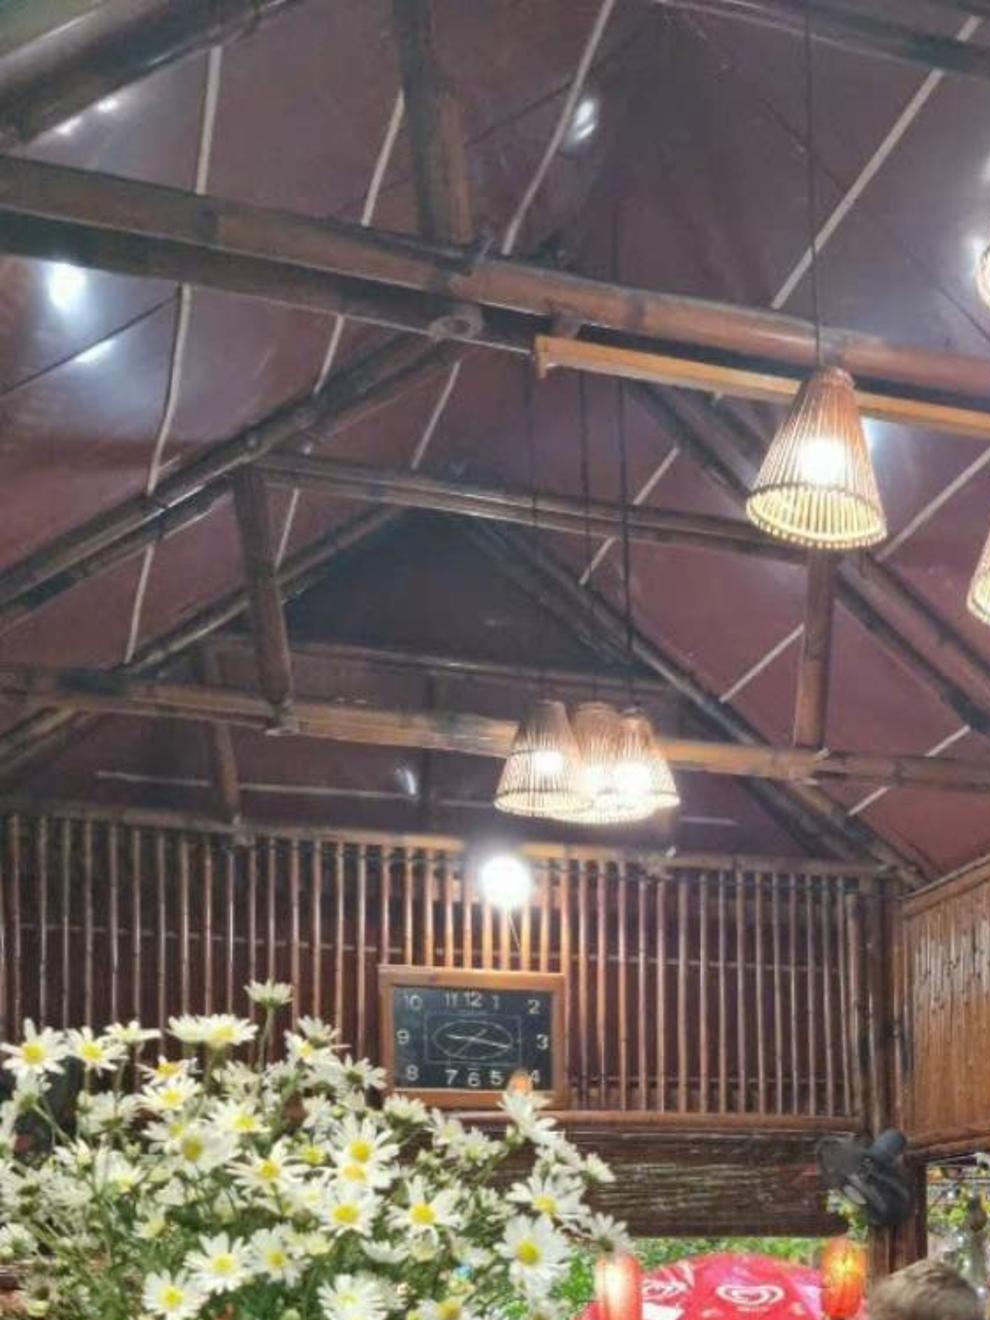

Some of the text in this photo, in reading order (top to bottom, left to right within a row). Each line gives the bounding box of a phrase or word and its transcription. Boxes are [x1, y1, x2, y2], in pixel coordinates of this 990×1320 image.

[445, 992, 458, 1009] 11
[464, 991, 483, 1009] 12
[492, 995, 500, 1010] 1
[527, 999, 541, 1015] 2
[396, 1028, 411, 1046] 9
[535, 1033, 549, 1051] 3
[405, 1064, 419, 1082] 8
[445, 1069, 459, 1085] 7
[467, 1071, 482, 1087] 6
[489, 1069, 504, 1086] 5
